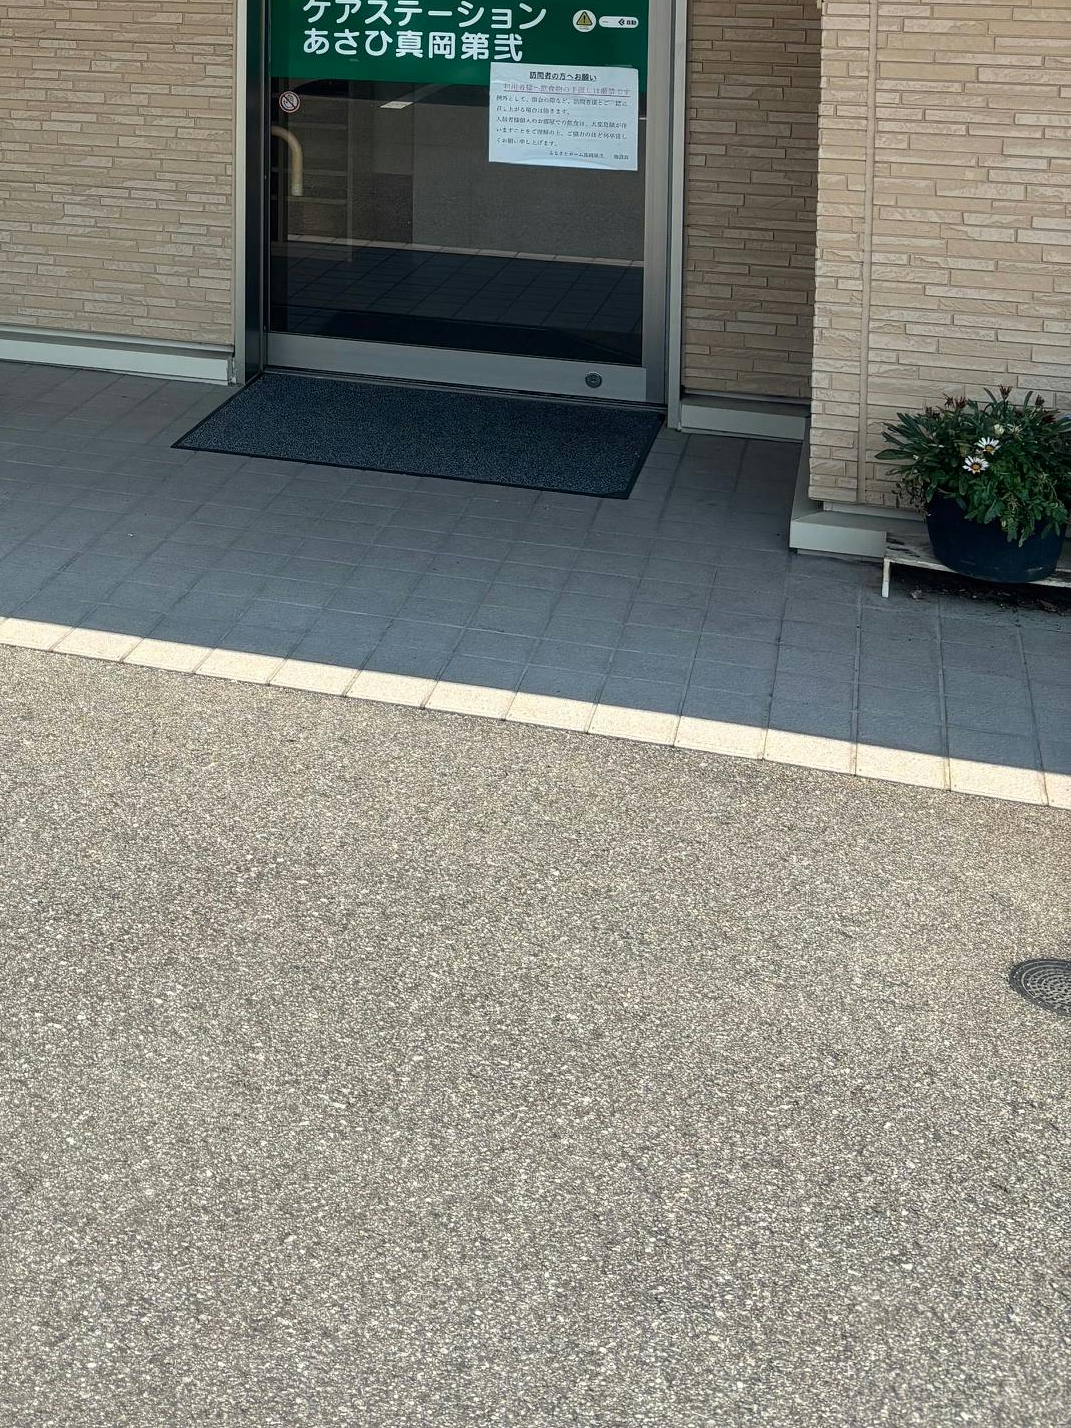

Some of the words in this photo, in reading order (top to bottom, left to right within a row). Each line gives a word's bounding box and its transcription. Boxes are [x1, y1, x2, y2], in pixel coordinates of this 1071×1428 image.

[302, 27, 523, 62] あさひ真岡第弐
[529, 71, 597, 81] 訪問者の方へお願い
